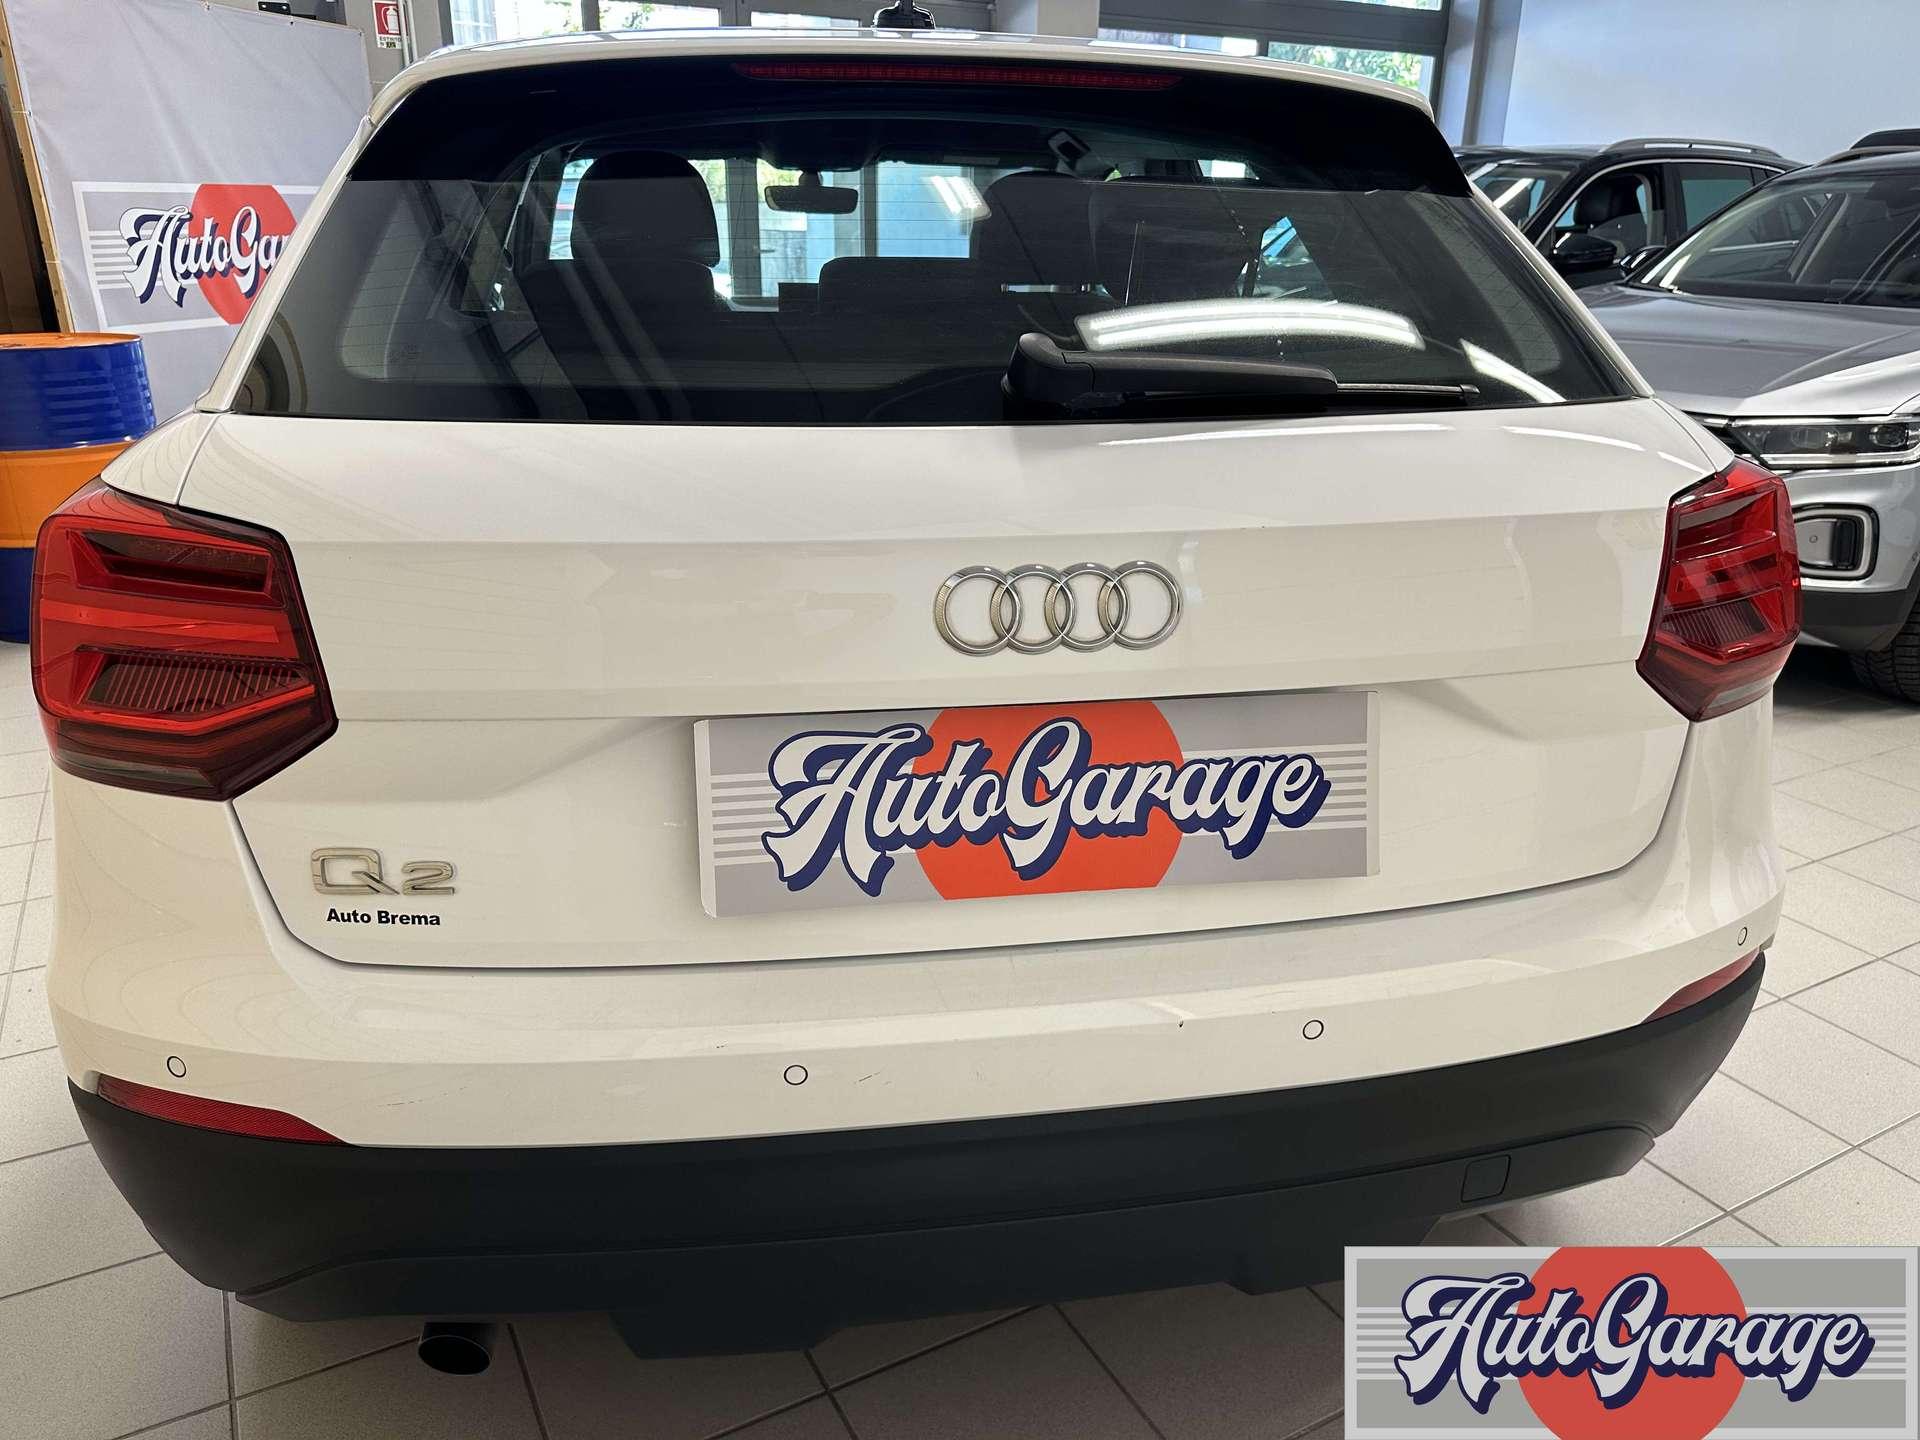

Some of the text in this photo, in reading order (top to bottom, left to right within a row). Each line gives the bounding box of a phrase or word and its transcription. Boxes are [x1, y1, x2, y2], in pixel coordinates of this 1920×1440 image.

[762, 717, 1331, 897] AutoGarage
[311, 847, 456, 896] Q2
[326, 908, 441, 926] Auto Brema
